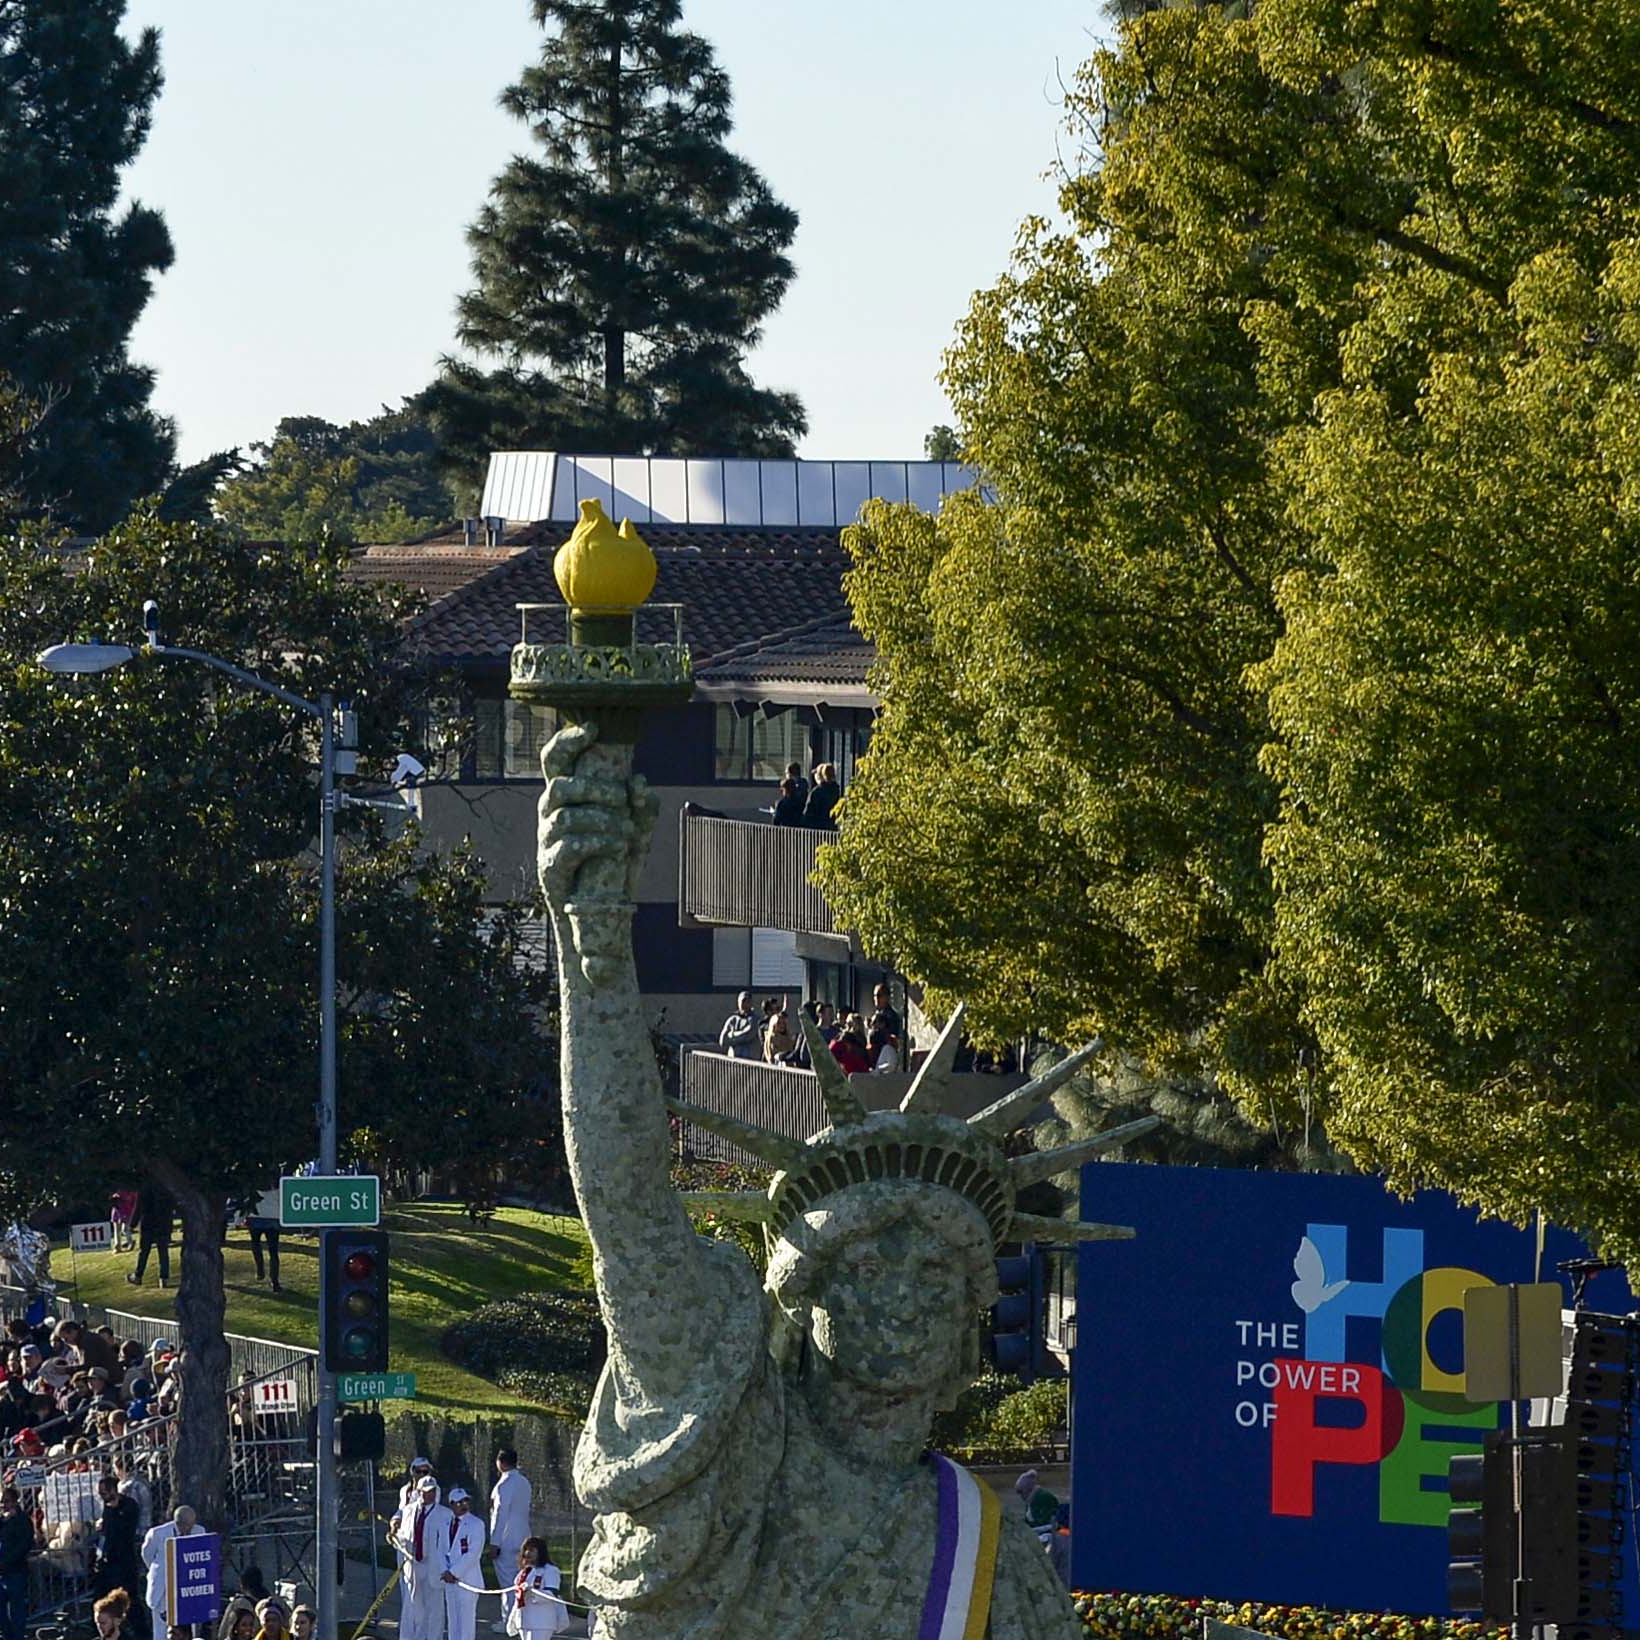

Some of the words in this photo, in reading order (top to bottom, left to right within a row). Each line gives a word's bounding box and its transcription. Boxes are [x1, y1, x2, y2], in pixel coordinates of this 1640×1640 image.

[290, 1192, 341, 1211] Green
[350, 1192, 369, 1210] St
[80, 1226, 105, 1243] 111
[1235, 1321, 1300, 1349] THE
[1236, 1360, 1361, 1393] POWER
[262, 1383, 288, 1401] 111
[344, 1377, 386, 1396] Green
[1235, 1401, 1279, 1428] OF
[183, 1550, 211, 1563] VOTES
[188, 1568, 206, 1580] FOR
[180, 1584, 214, 1598] WOMEN
